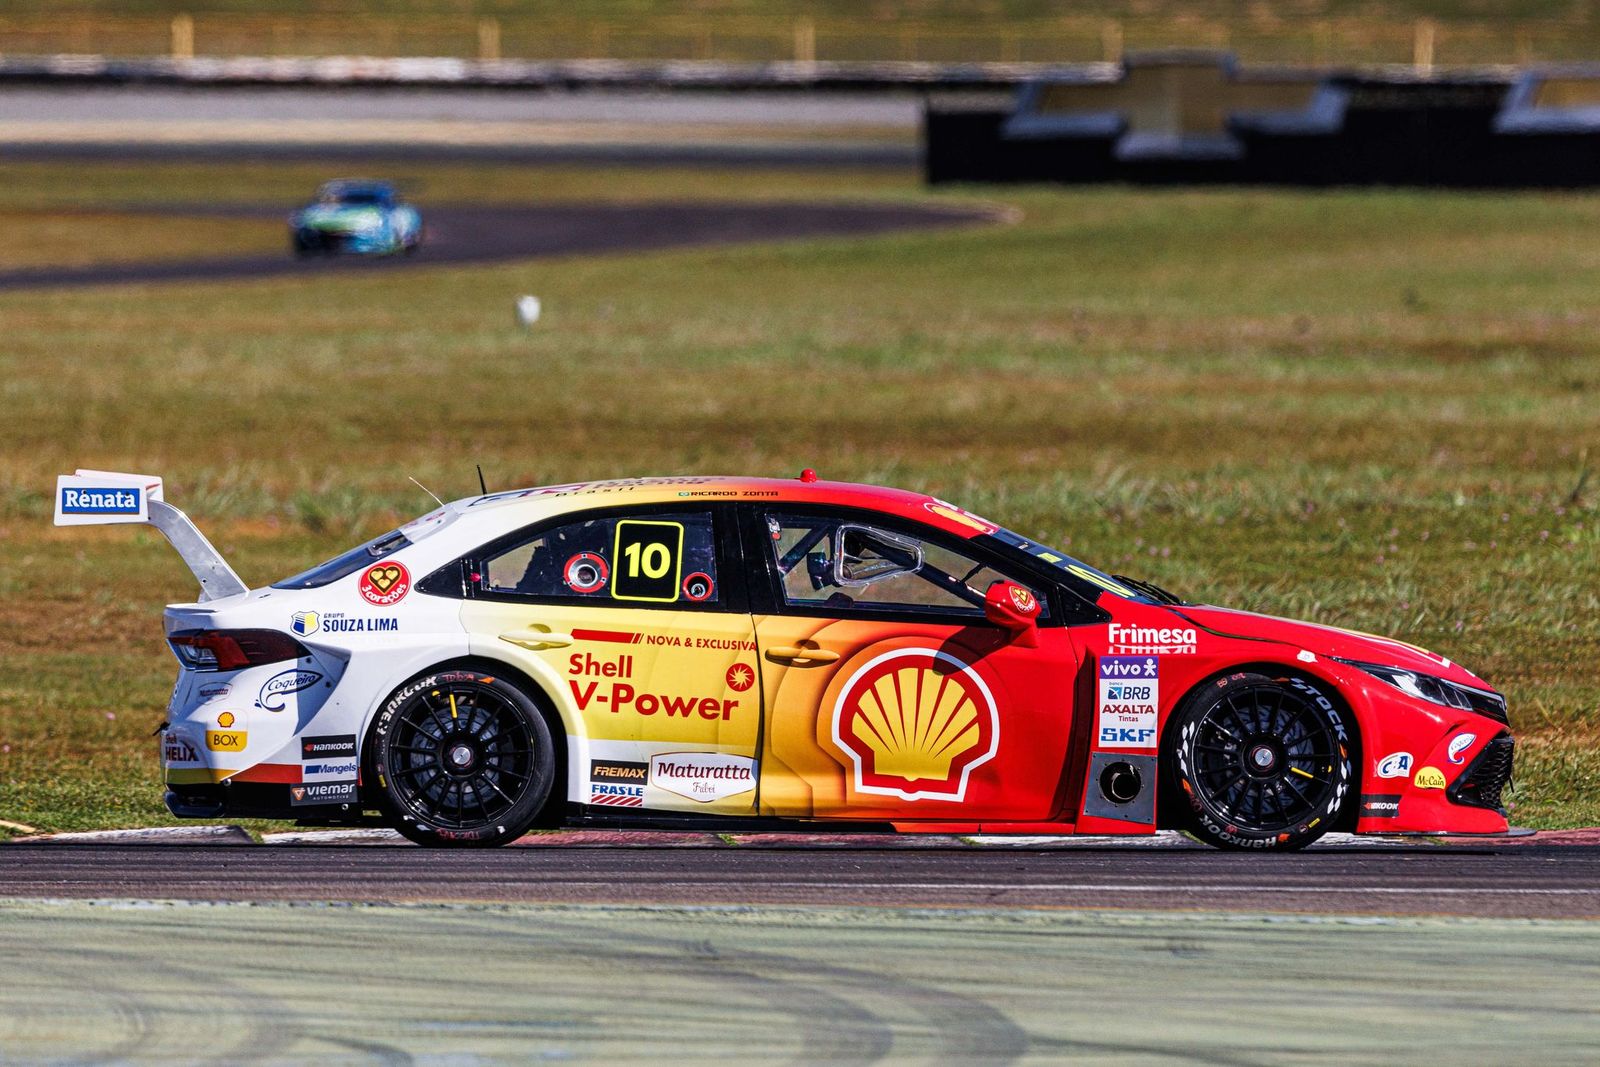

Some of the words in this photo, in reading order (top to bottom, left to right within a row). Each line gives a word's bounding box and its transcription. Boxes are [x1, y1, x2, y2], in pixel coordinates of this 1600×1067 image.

[64, 490, 136, 508] Renata
[624, 542, 671, 579] 10
[361, 585, 372, 593] 3
[323, 619, 364, 633] SOUZA
[367, 618, 398, 631] LIMA
[1108, 623, 1197, 645] Frimesa
[646, 635, 681, 647] NOVA
[684, 638, 693, 648] &
[696, 638, 757, 651] EXCLUSIVA
[568, 652, 633, 679] Shell
[1101, 660, 1141, 676] vivo
[267, 673, 317, 691] Coqueiro
[568, 680, 739, 721] V-Power
[1122, 687, 1151, 700] BRB
[1101, 704, 1155, 714] AXALTA
[213, 734, 239, 746] BOX
[1101, 728, 1155, 742] SKF
[165, 746, 200, 762] HELIX
[319, 763, 357, 774] Mangels
[593, 766, 646, 779] FREMAX
[657, 762, 751, 780] Maturatta
